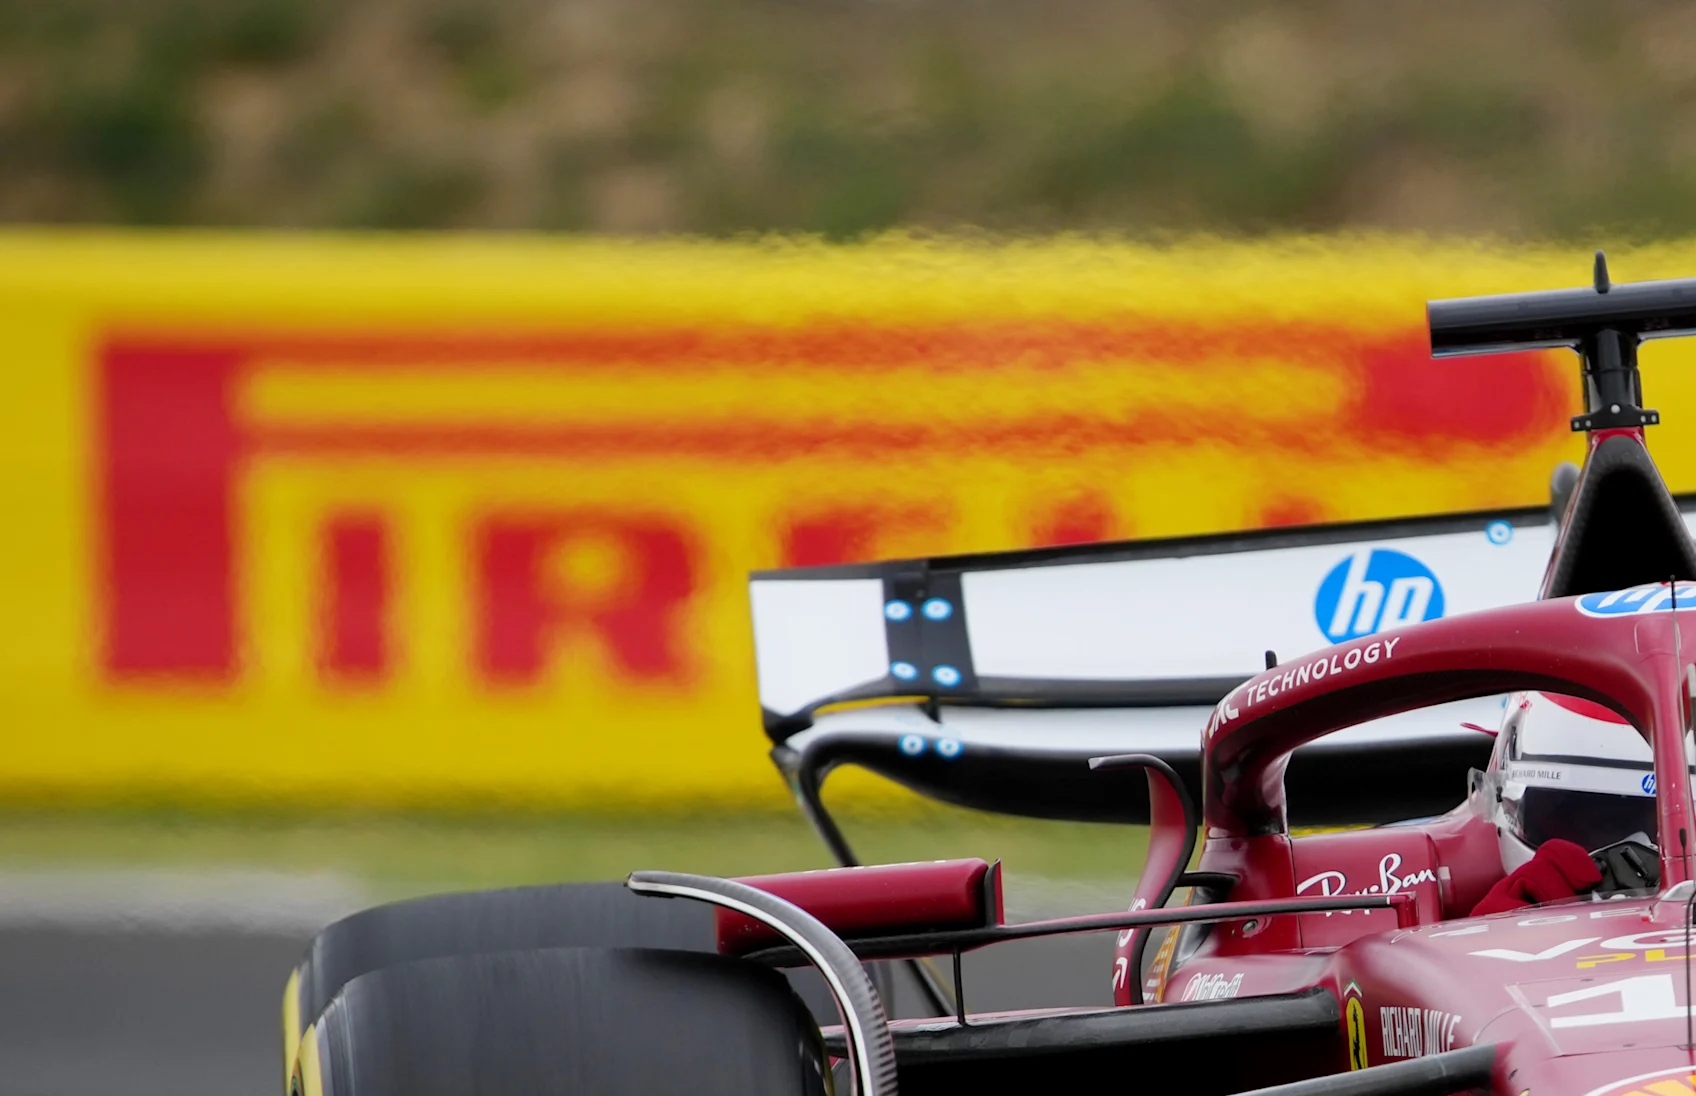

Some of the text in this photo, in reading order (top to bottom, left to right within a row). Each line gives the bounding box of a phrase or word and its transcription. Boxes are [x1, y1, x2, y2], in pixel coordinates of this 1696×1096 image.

[1327, 549, 1436, 636] hp
[1246, 637, 1400, 707] TECHNOLOGY
[1380, 1006, 1462, 1058] RICHARD MILLE
